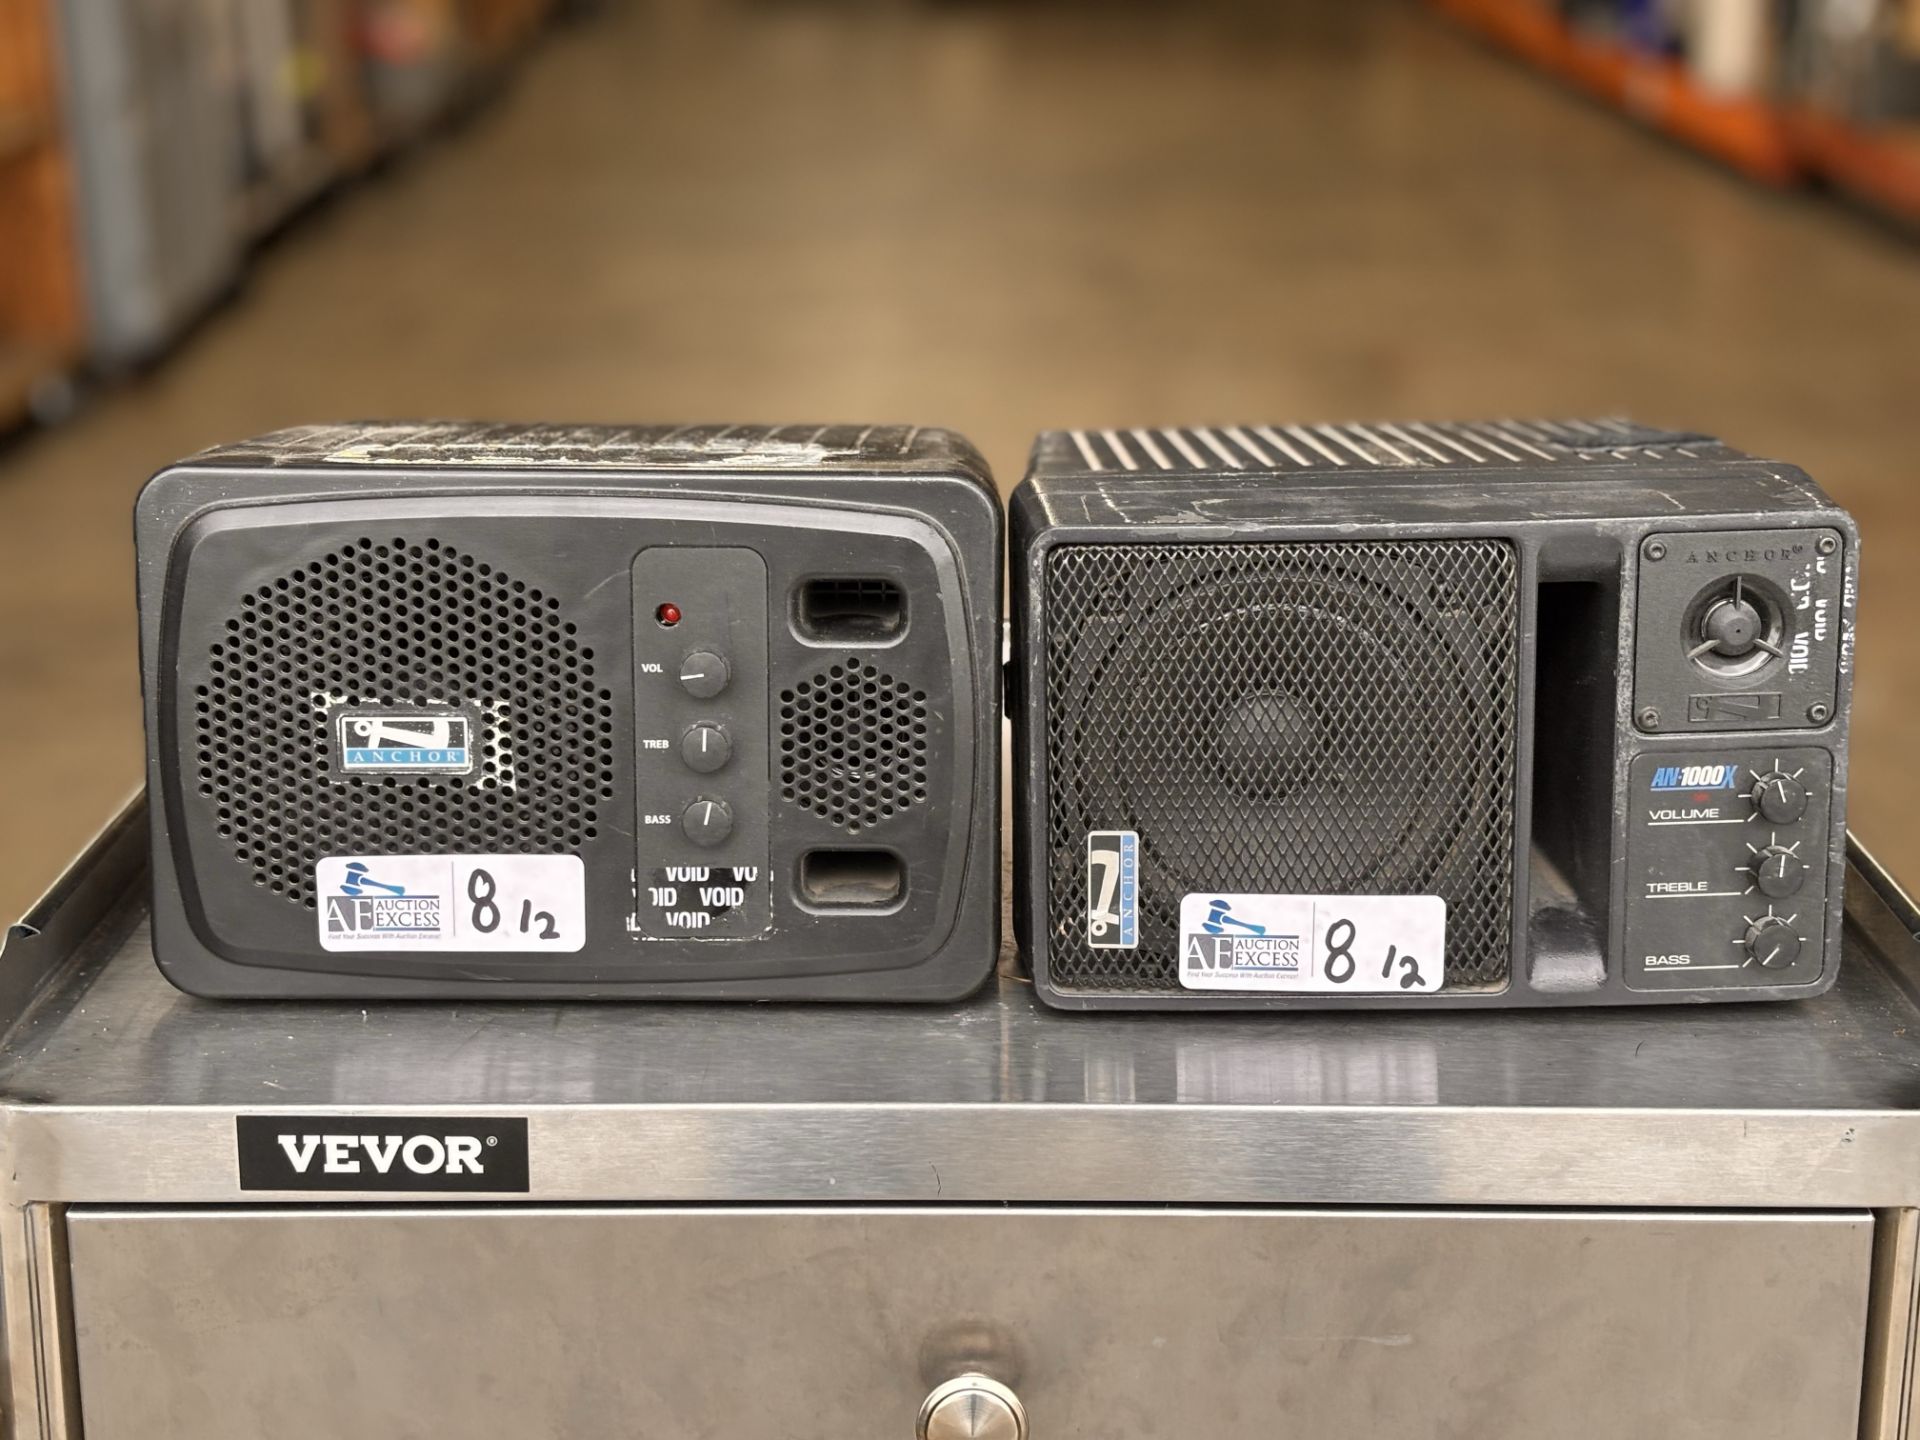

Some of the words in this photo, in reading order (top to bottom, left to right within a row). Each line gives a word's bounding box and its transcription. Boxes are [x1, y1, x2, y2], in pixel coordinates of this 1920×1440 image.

[641, 663, 664, 673] VOL
[643, 739, 670, 749] TREB
[645, 815, 672, 825] BASS
[1649, 808, 1720, 820] VOLUME
[665, 867, 710, 882] VOID
[1123, 844, 1134, 937] ANCHOR
[1646, 881, 1708, 893] TREBLE
[467, 868, 501, 933] 8
[699, 887, 744, 907] VOID
[376, 899, 440, 911] AUCTION
[376, 912, 440, 927] EXCESS
[665, 911, 711, 929] VOID
[1235, 939, 1299, 950] AUCTION
[1323, 918, 1357, 984] 8
[1235, 951, 1299, 967] EXCESS
[1645, 955, 1691, 966] BASS
